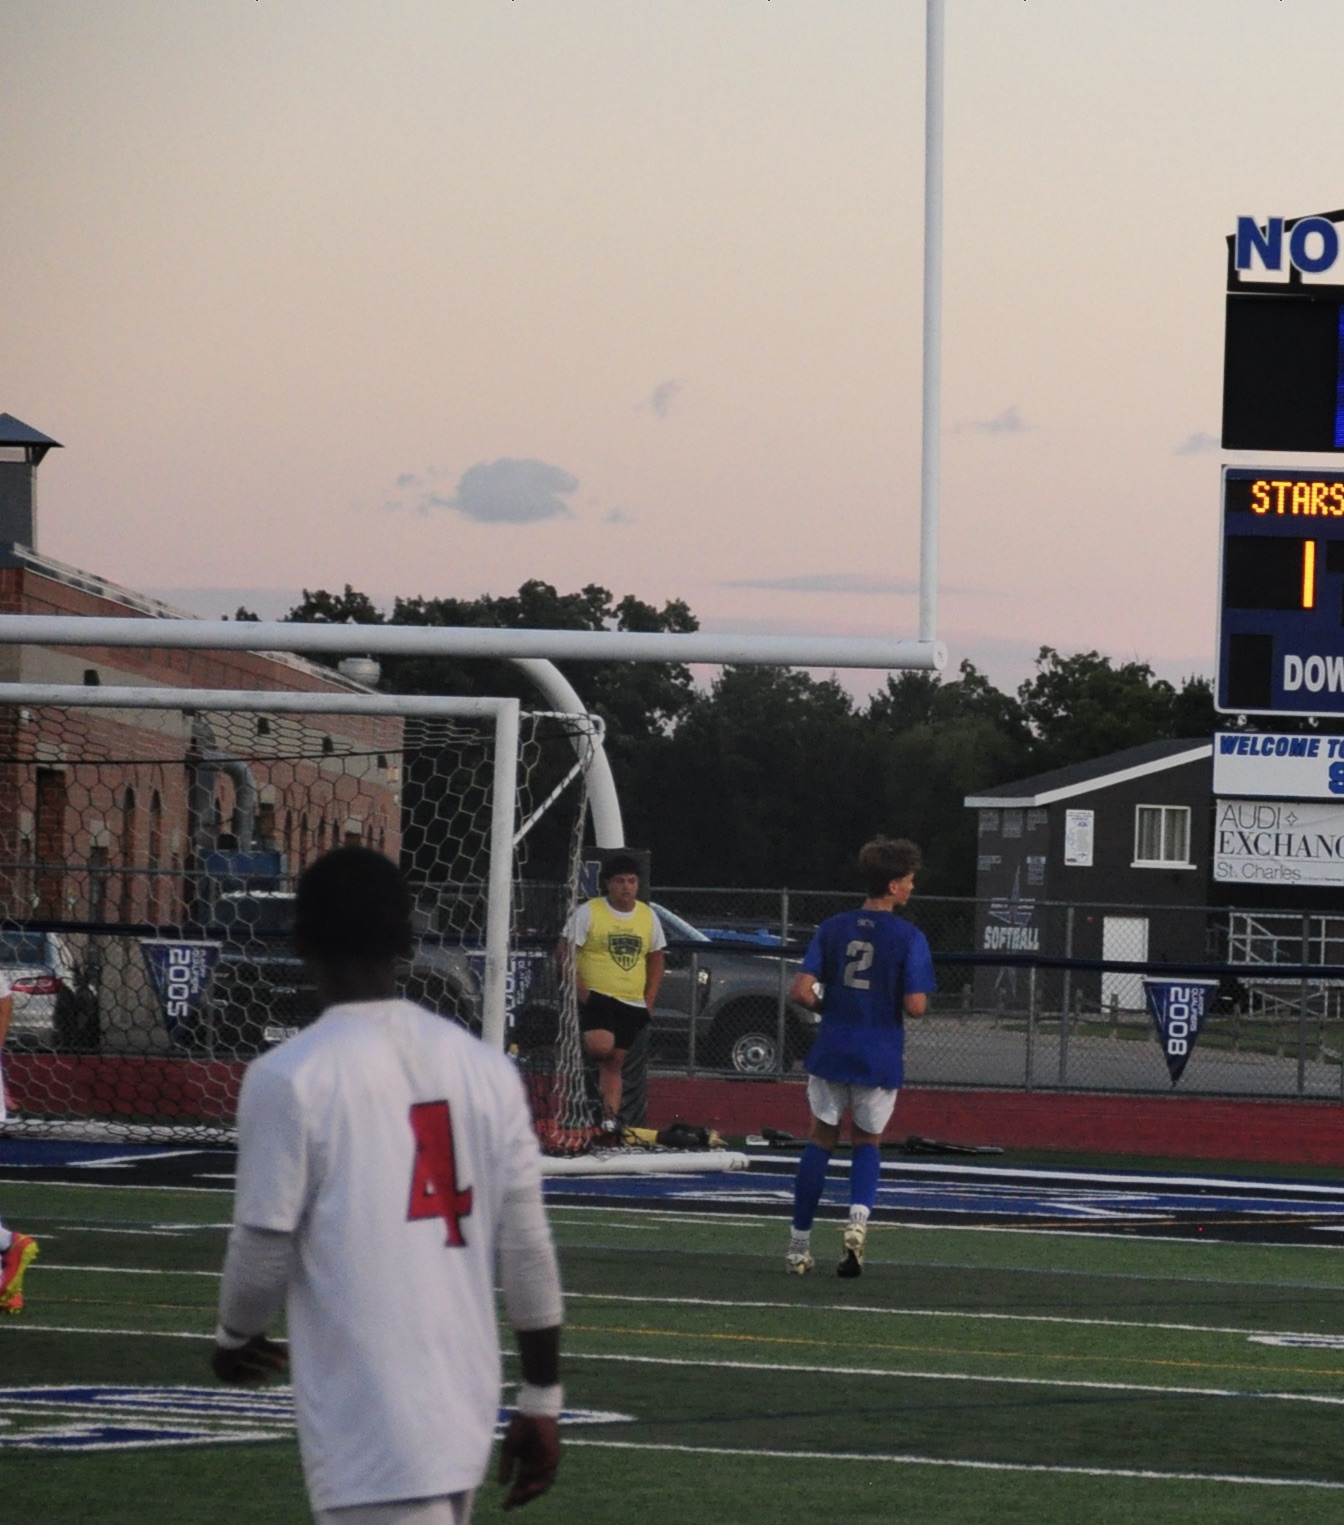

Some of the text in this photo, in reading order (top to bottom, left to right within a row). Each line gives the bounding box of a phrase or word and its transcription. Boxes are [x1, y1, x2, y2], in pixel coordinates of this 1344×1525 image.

[1302, 539, 1316, 610] 1
[1219, 735, 1321, 758] WELCOME
[1219, 804, 1282, 831] AUDI
[1216, 861, 1302, 881] St. Charles
[983, 925, 1040, 951] SOFTBALL
[167, 948, 191, 1017] 2005
[844, 939, 874, 990] 2
[1167, 986, 1190, 1056] 2008
[405, 1099, 474, 1249] 4
